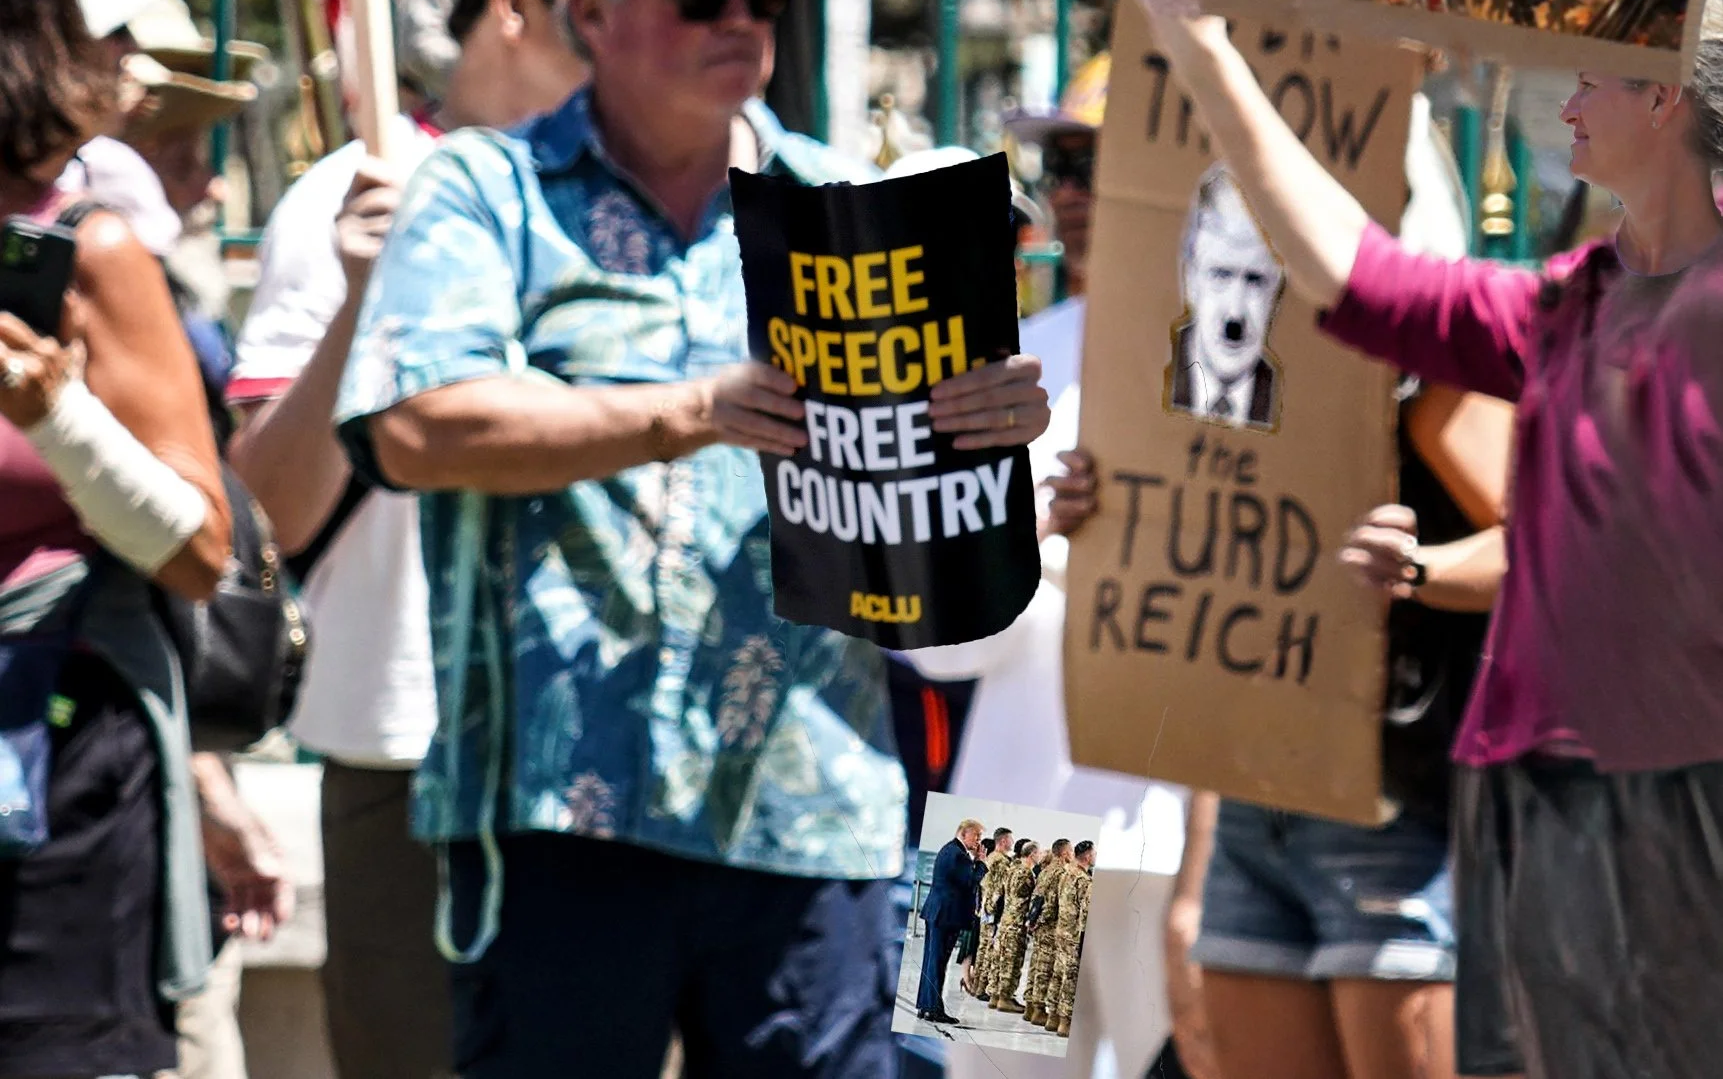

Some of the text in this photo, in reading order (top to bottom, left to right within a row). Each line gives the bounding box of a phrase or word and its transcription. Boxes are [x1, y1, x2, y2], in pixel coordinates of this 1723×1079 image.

[788, 244, 930, 320] FREE
[805, 400, 936, 472] FREE
[1187, 433, 1260, 486] the
[776, 457, 1015, 546] COUNTRY
[1113, 471, 1321, 593] TURD
[850, 591, 922, 624] ACLU
[1090, 579, 1320, 685] REICH
